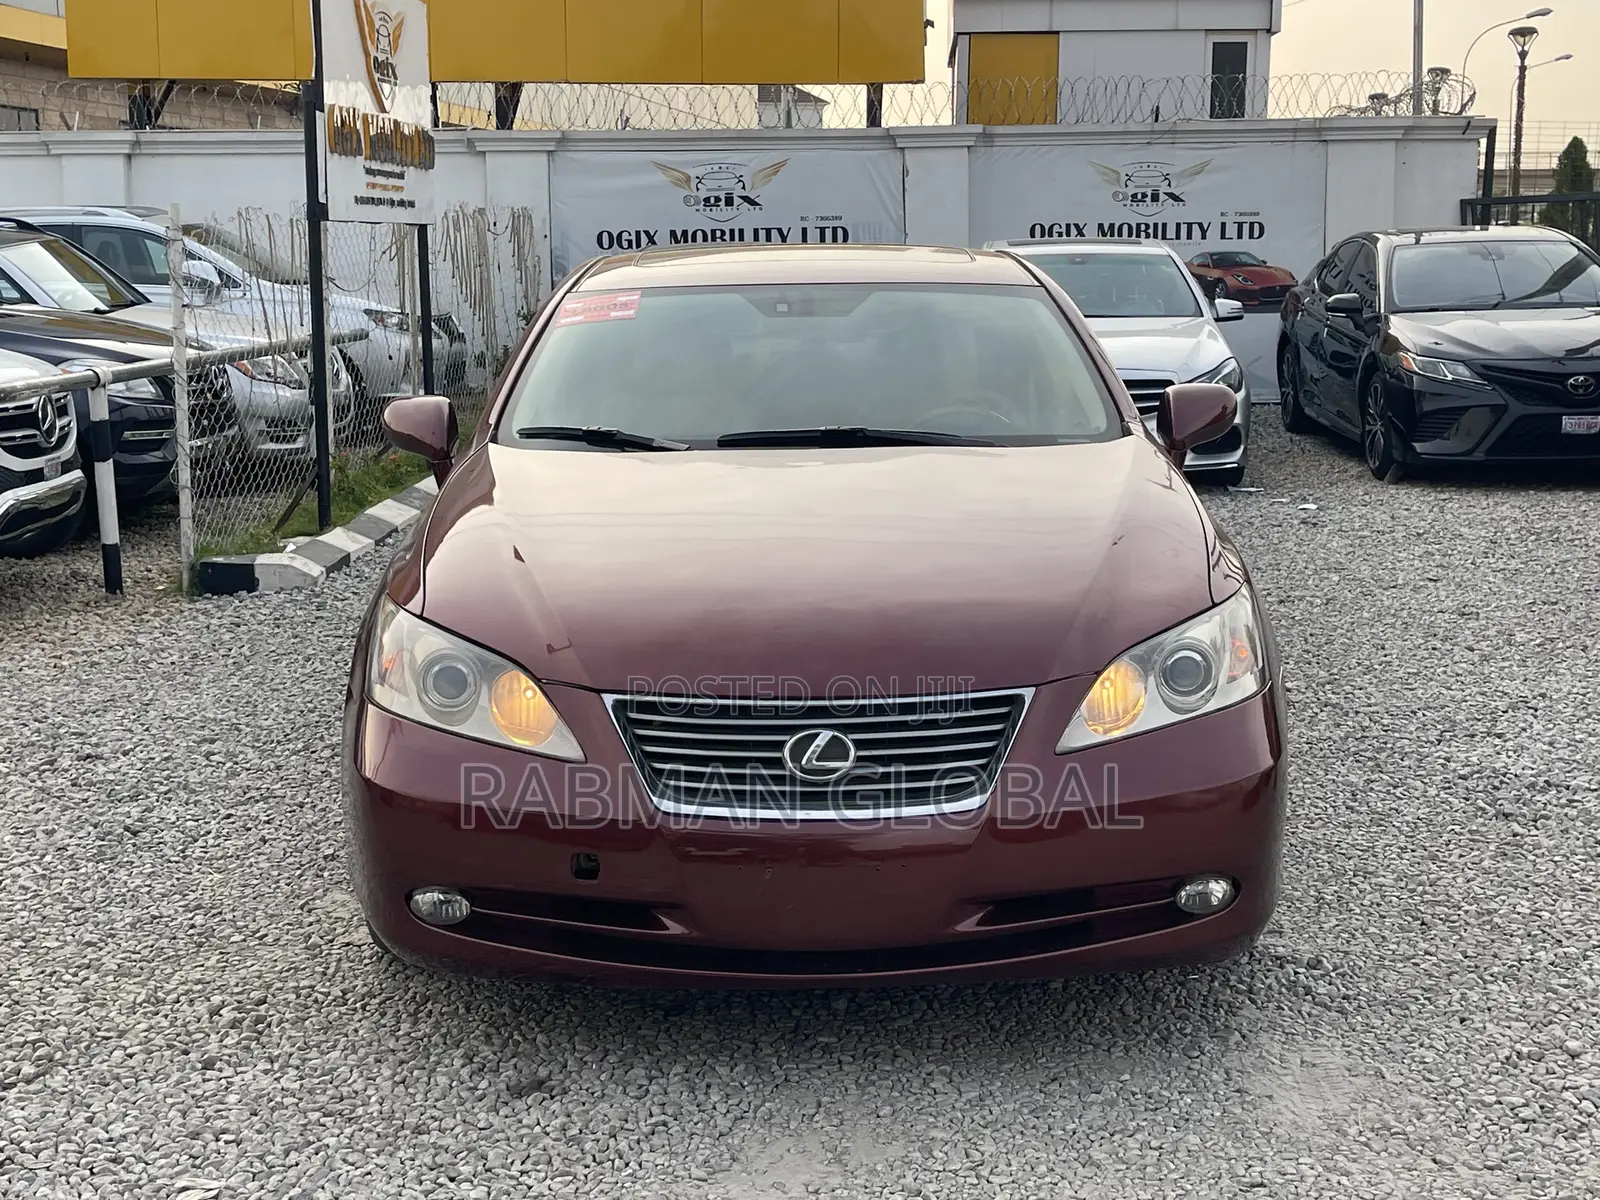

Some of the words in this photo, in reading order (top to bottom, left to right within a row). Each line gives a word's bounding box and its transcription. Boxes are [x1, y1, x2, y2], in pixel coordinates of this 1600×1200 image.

[596, 229, 659, 250] OGIX
[669, 227, 792, 244] MOBILITY
[801, 225, 850, 243] LTD
[1029, 222, 1088, 238] OGIX
[1097, 221, 1212, 240] MOBILITY
[1220, 221, 1266, 240] LTD
